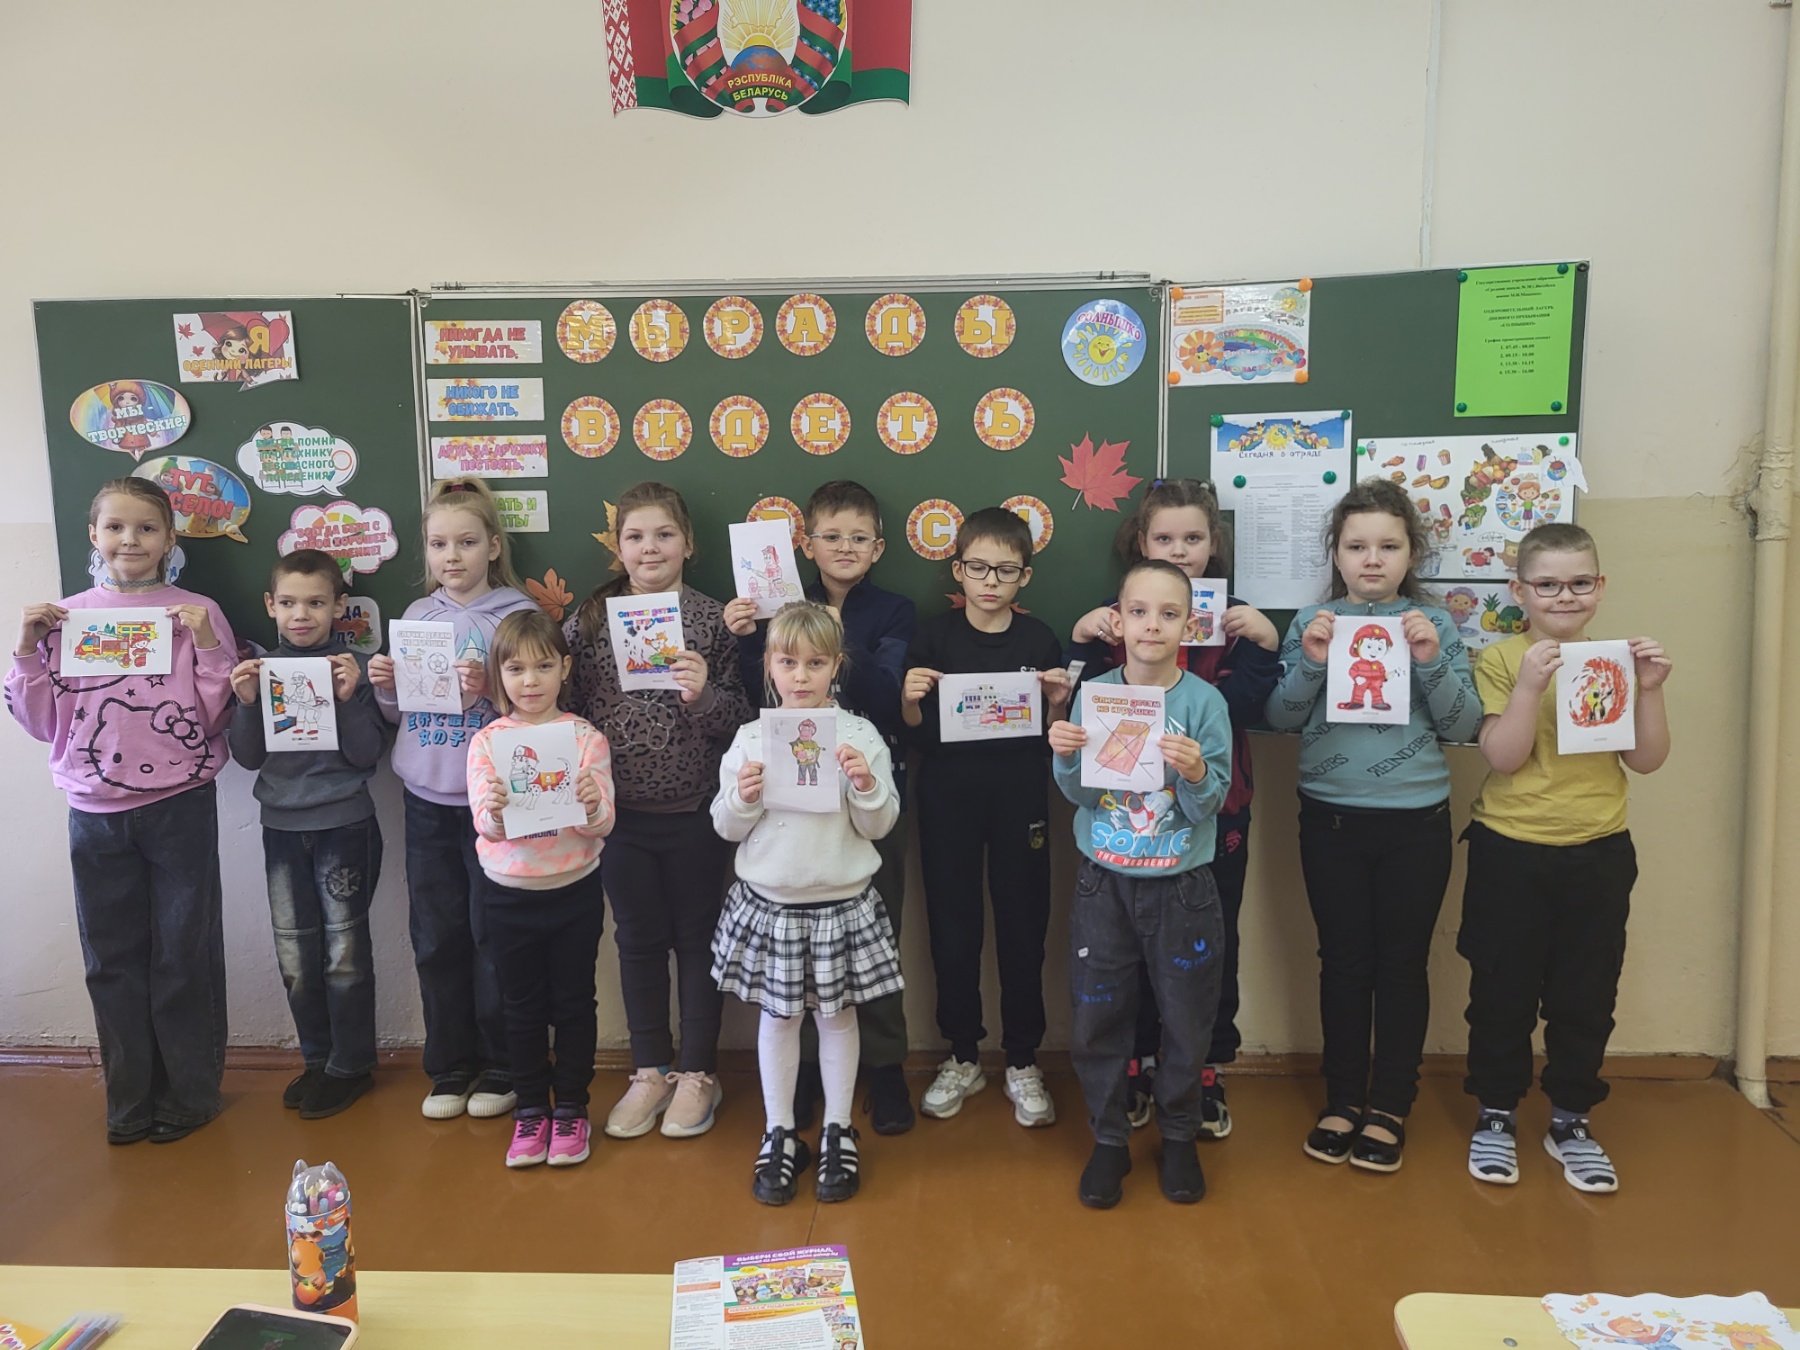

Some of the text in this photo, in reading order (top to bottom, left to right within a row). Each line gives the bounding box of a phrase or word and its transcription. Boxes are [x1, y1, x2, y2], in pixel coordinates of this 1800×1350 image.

[727, 73, 792, 89] РЭСПУБЛІКА
[732, 87, 788, 101] БЕЛАРУСЬ
[1077, 312, 1142, 341] СОЛНЫШКО
[248, 325, 270, 354] Я
[440, 327, 526, 343] НИКОГДА НЕ
[448, 345, 519, 359] УНЫВАТЬ,
[183, 358, 242, 372] ОСЕННИЙ
[446, 385, 520, 399] НИКОГО НЕ
[115, 404, 144, 419] МЫ
[448, 402, 519, 417] ОБИЖАТЬ,
[298, 436, 336, 446] ПОМНИ
[285, 448, 333, 459] ТЕХНИКУ
[438, 443, 468, 459] ДРУГ
[473, 444, 489, 457] ЗА
[262, 459, 335, 470] ЗОАСНОГО
[461, 458, 524, 471] ПОСТОЯТЬ,
[168, 467, 214, 493] ТУТ
[165, 490, 235, 520] СЕЛО!
[527, 497, 538, 511] И
[296, 520, 380, 538] ВСЕГДА БЕРИ С
[333, 532, 387, 547] ХОРОШЕЕ
[326, 545, 381, 559] ТРОЕНИЕ!
[408, 711, 494, 734] 世界で最高
[418, 729, 466, 748] 女の子
[1091, 821, 1192, 857] SONIC
[1096, 850, 1116, 863] THE
